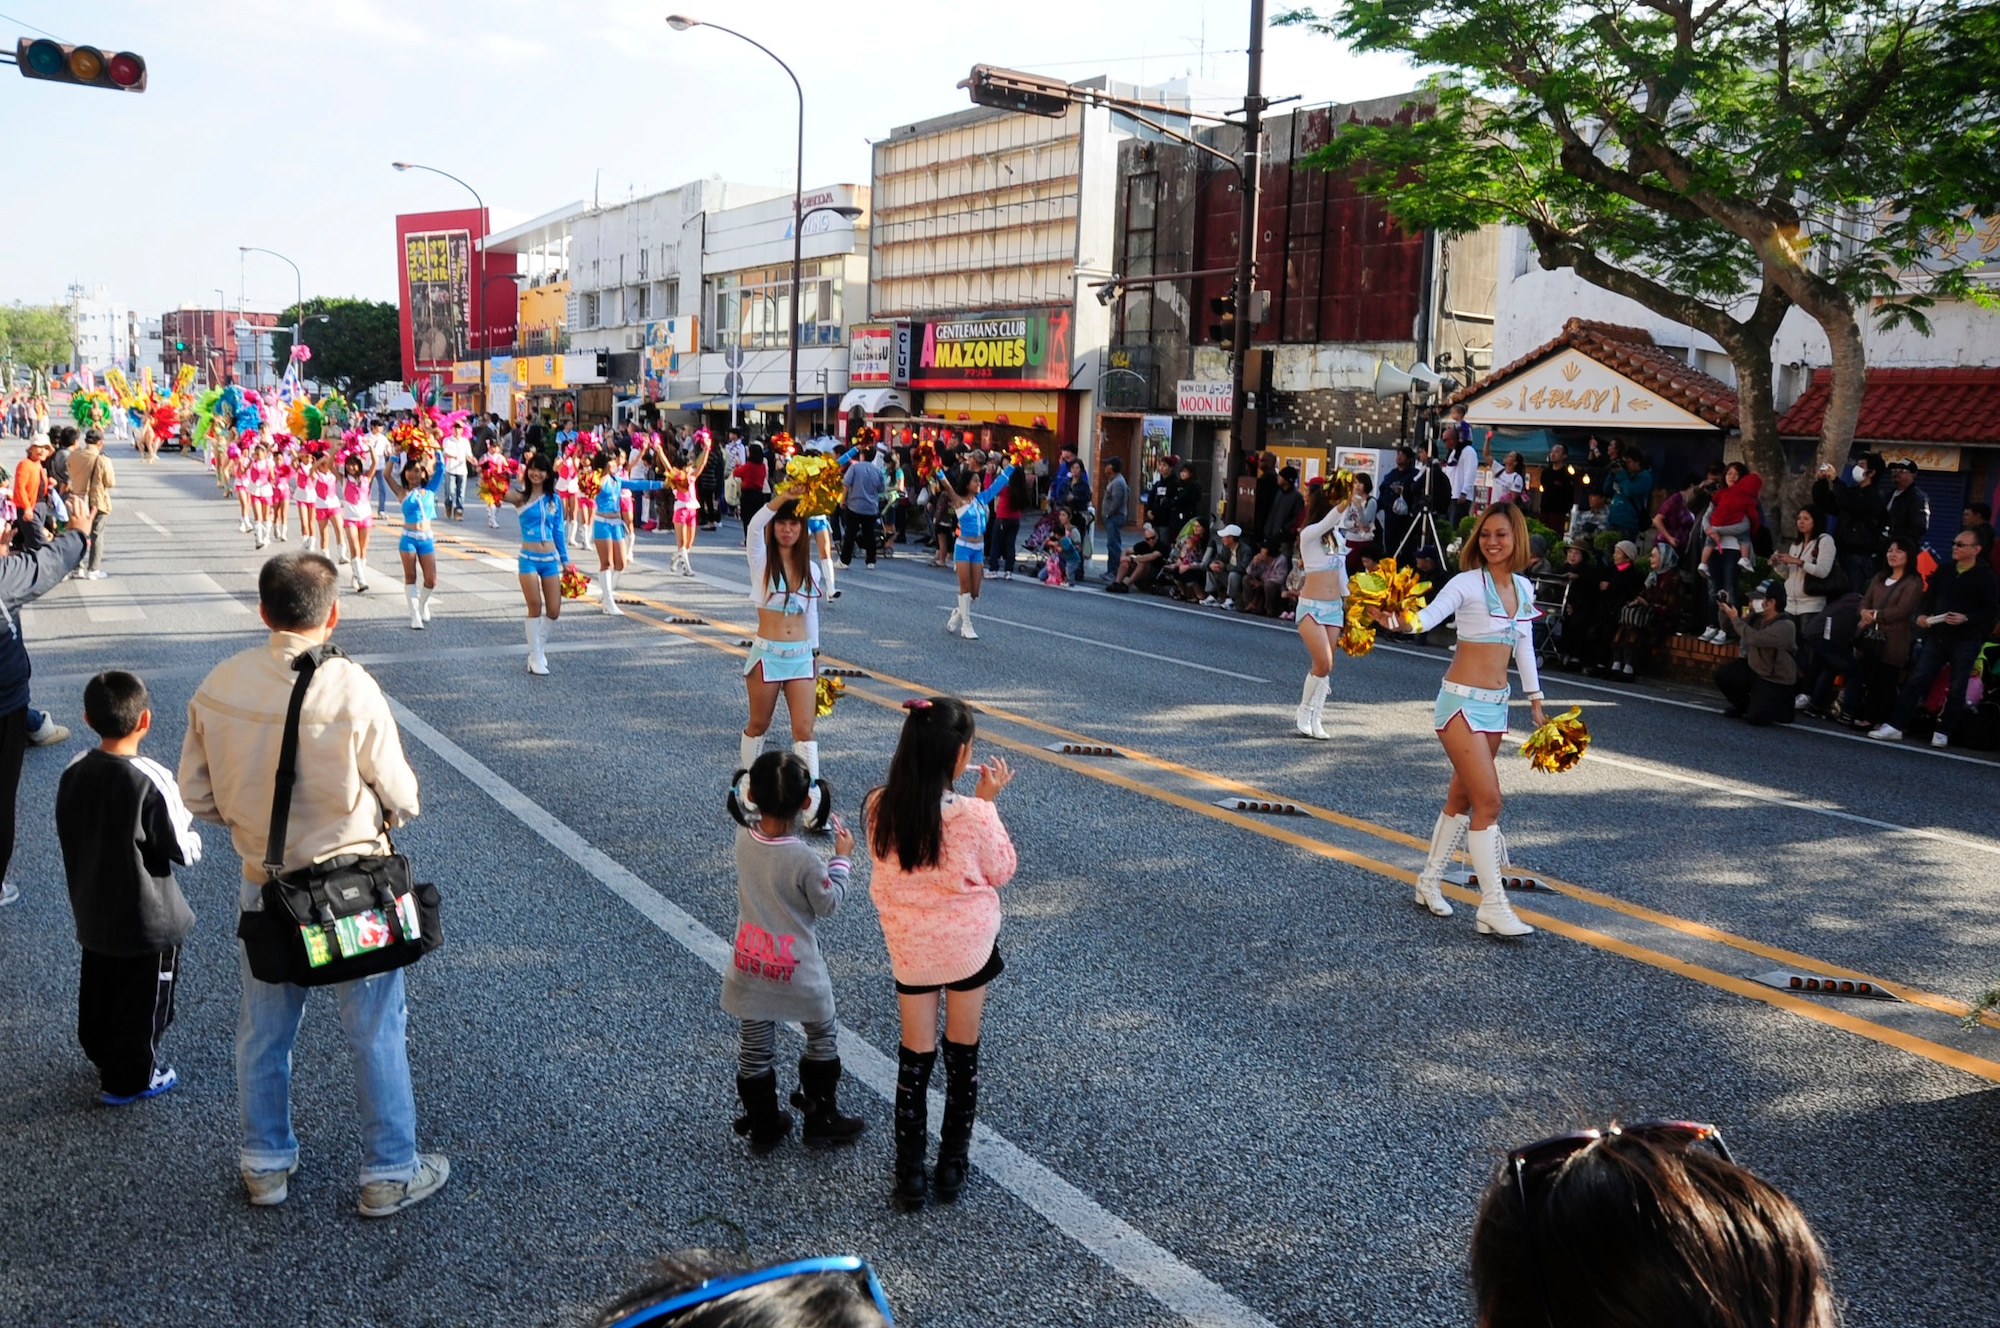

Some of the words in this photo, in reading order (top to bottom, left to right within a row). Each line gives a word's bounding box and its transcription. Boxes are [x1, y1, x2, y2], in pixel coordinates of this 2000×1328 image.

[999, 320, 1026, 337] CLUB
[898, 332, 907, 378] CLUB
[1209, 383, 1233, 395] ムーンラ
[1180, 396, 1212, 412] MOON
[1215, 396, 1232, 412] LIG
